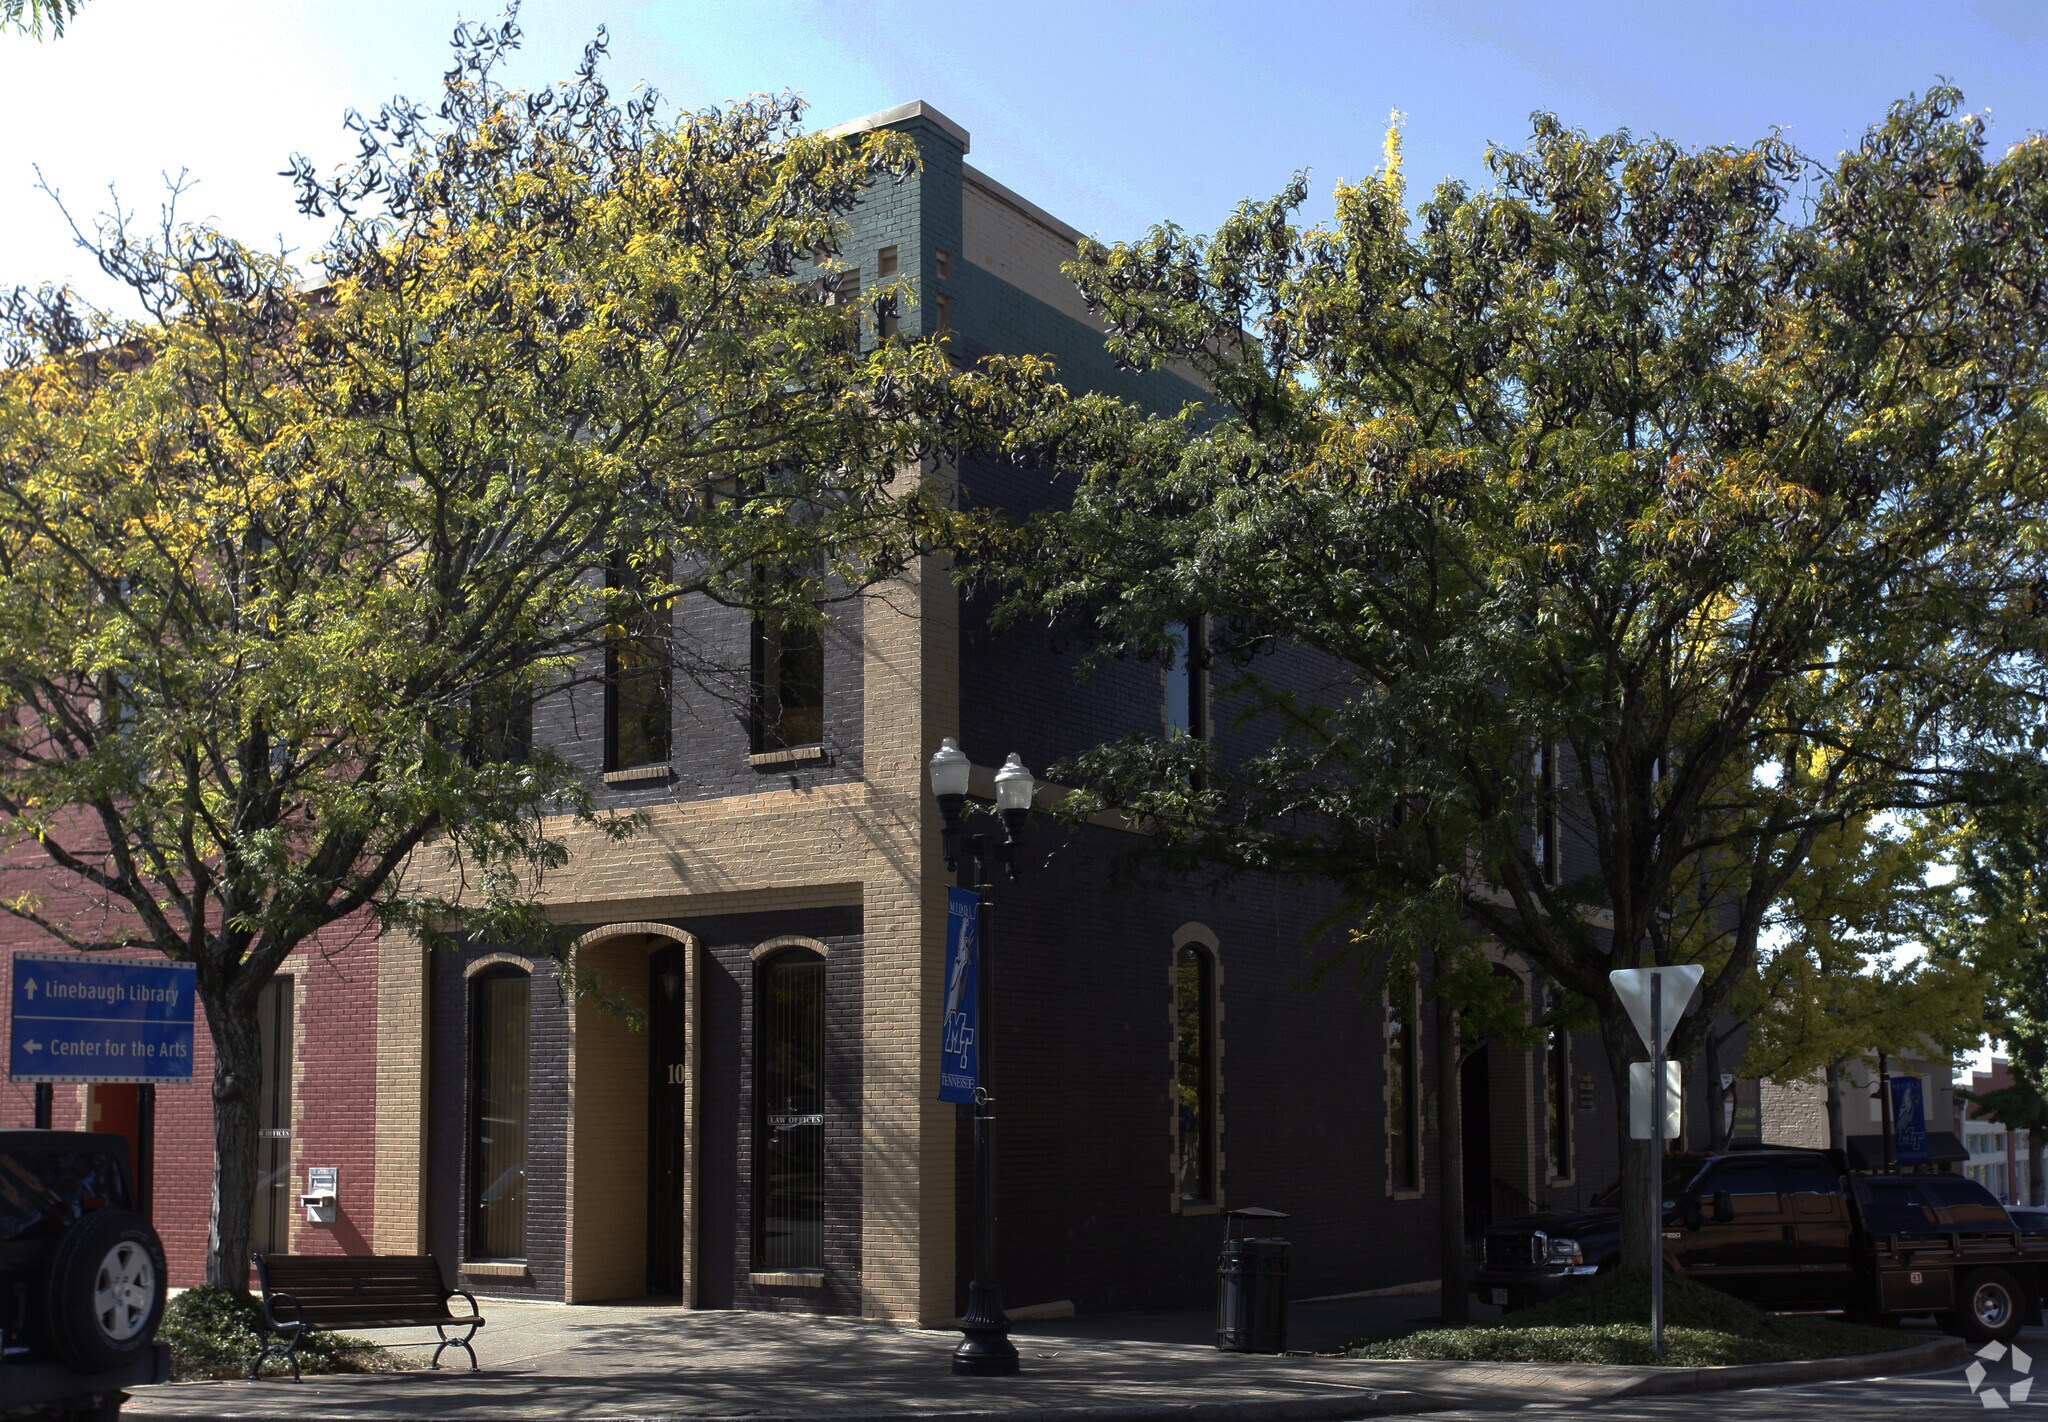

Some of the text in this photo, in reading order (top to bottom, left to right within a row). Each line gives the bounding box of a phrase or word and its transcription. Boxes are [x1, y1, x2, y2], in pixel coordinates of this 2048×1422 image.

[45, 980, 179, 1006] Linebaugh Library
[50, 1039, 187, 1057] Center for the Arts
[945, 1010, 974, 1069] MT
[770, 1116, 821, 1124] LAW OFFICES
[1898, 1126, 1925, 1151] MT
